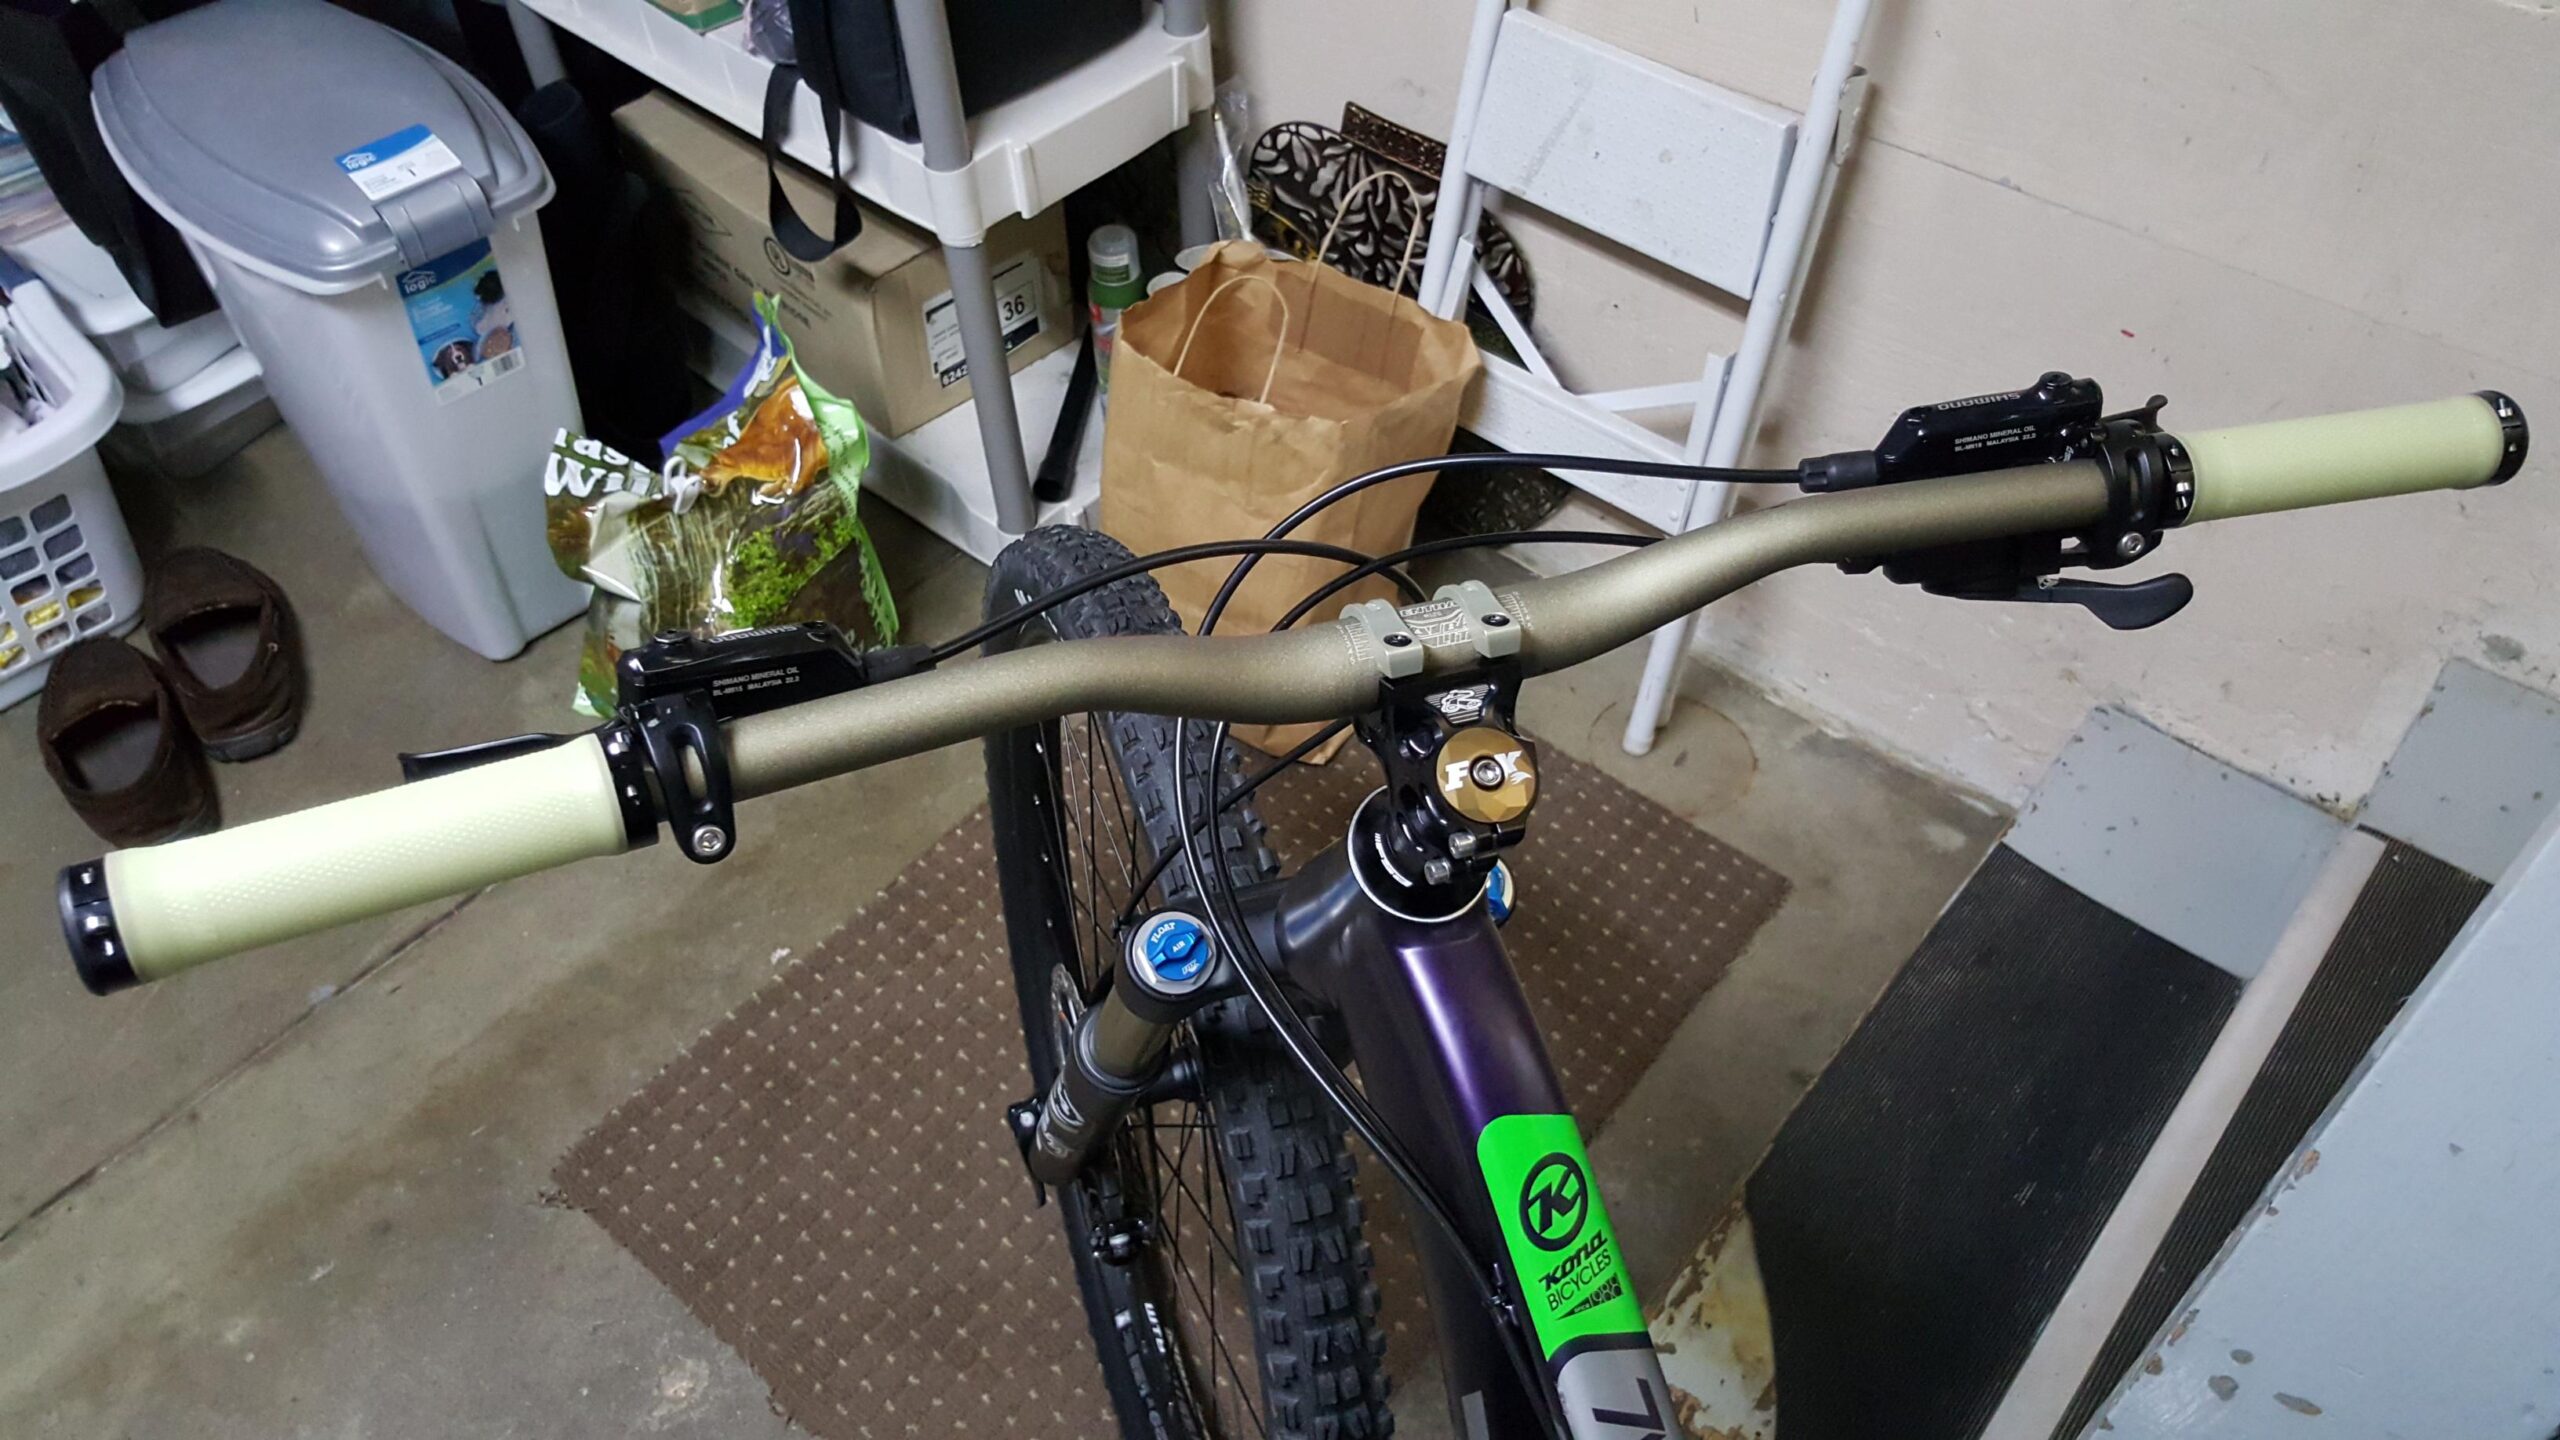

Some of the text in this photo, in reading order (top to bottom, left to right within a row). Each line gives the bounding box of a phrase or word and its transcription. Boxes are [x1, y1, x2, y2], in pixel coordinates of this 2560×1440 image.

[404, 274, 437, 294] logic
[1003, 294, 1025, 321] 36
[1937, 392, 2021, 411] SHIMANO
[1954, 425, 2036, 445] SHIMANO MINERAL OIL
[1986, 436, 2020, 447] MALAYSIA
[709, 624, 798, 644] SHIMANO
[712, 666, 800, 688] SHIMANO MINERAL OIL
[747, 679, 783, 691] MALAYSIA
[785, 675, 800, 685] 22.2
[1150, 922, 1176, 944] FLOAT
[1172, 940, 1186, 953] AIR
[1547, 1248, 1612, 1312] BICYCLES
[1589, 1274, 1623, 1307] 1988
